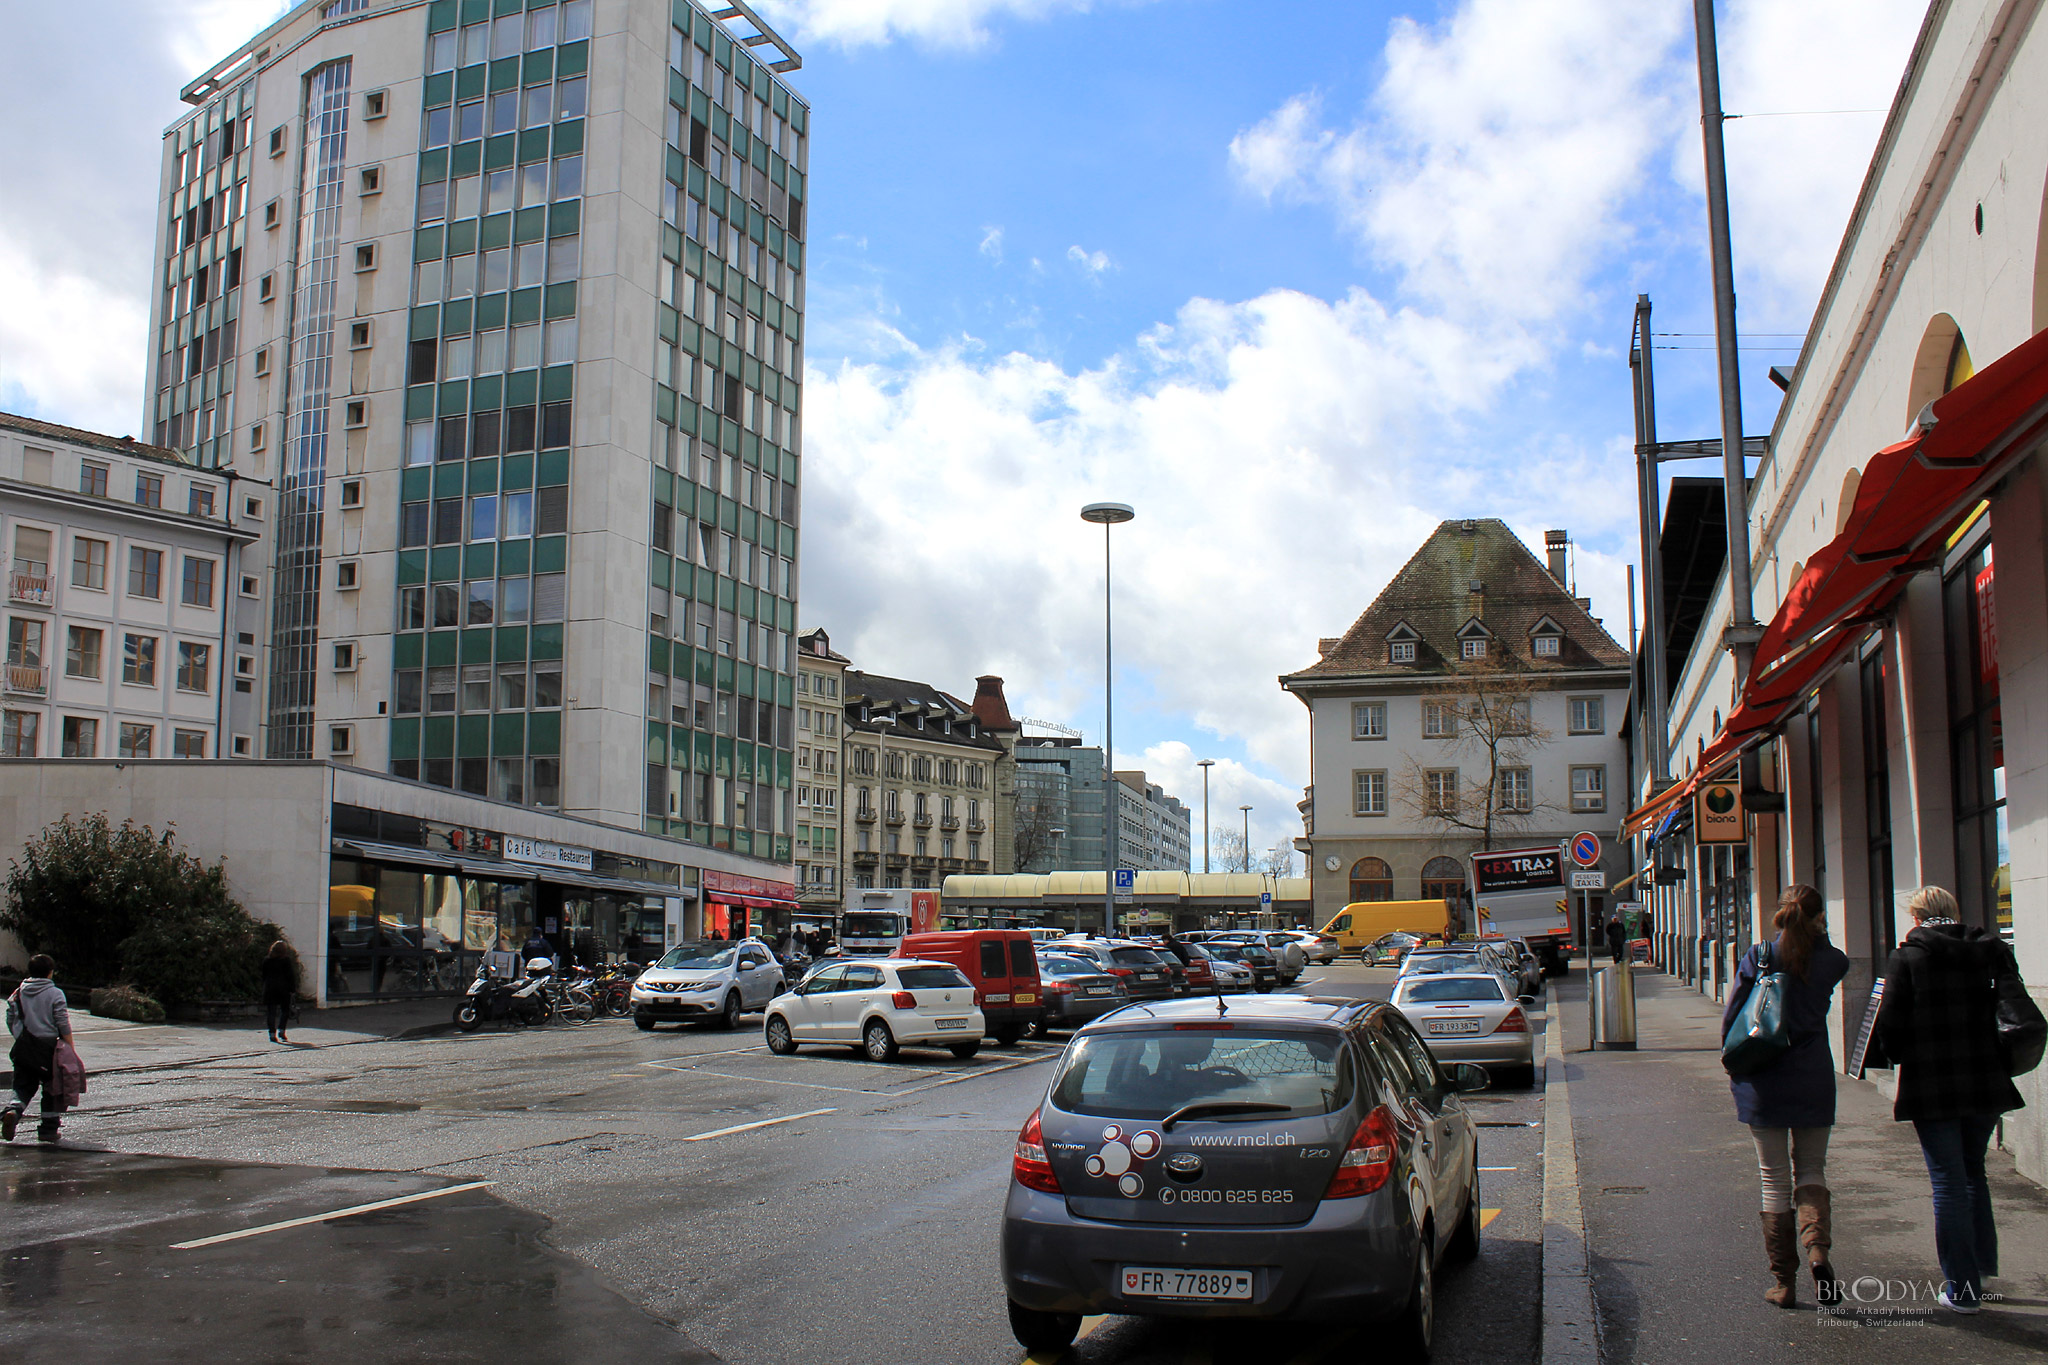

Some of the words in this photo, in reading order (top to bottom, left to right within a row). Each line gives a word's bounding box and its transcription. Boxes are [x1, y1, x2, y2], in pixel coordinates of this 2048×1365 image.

[1021, 715, 1084, 738] Kantonalbank
[1705, 814, 1736, 823] biona
[507, 839, 531, 856] Café
[534, 840, 557, 860] Centre
[559, 847, 591, 866] Restaurant
[1526, 869, 1554, 877] LOGISTICS
[1576, 879, 1601, 887] TAXIS
[1190, 1131, 1296, 1147] www.mcl.ch
[1300, 1148, 1331, 1158] i20
[1180, 1189, 1222, 1203] 0800
[1226, 1190, 1257, 1203] 625
[1261, 1190, 1294, 1203] 625
